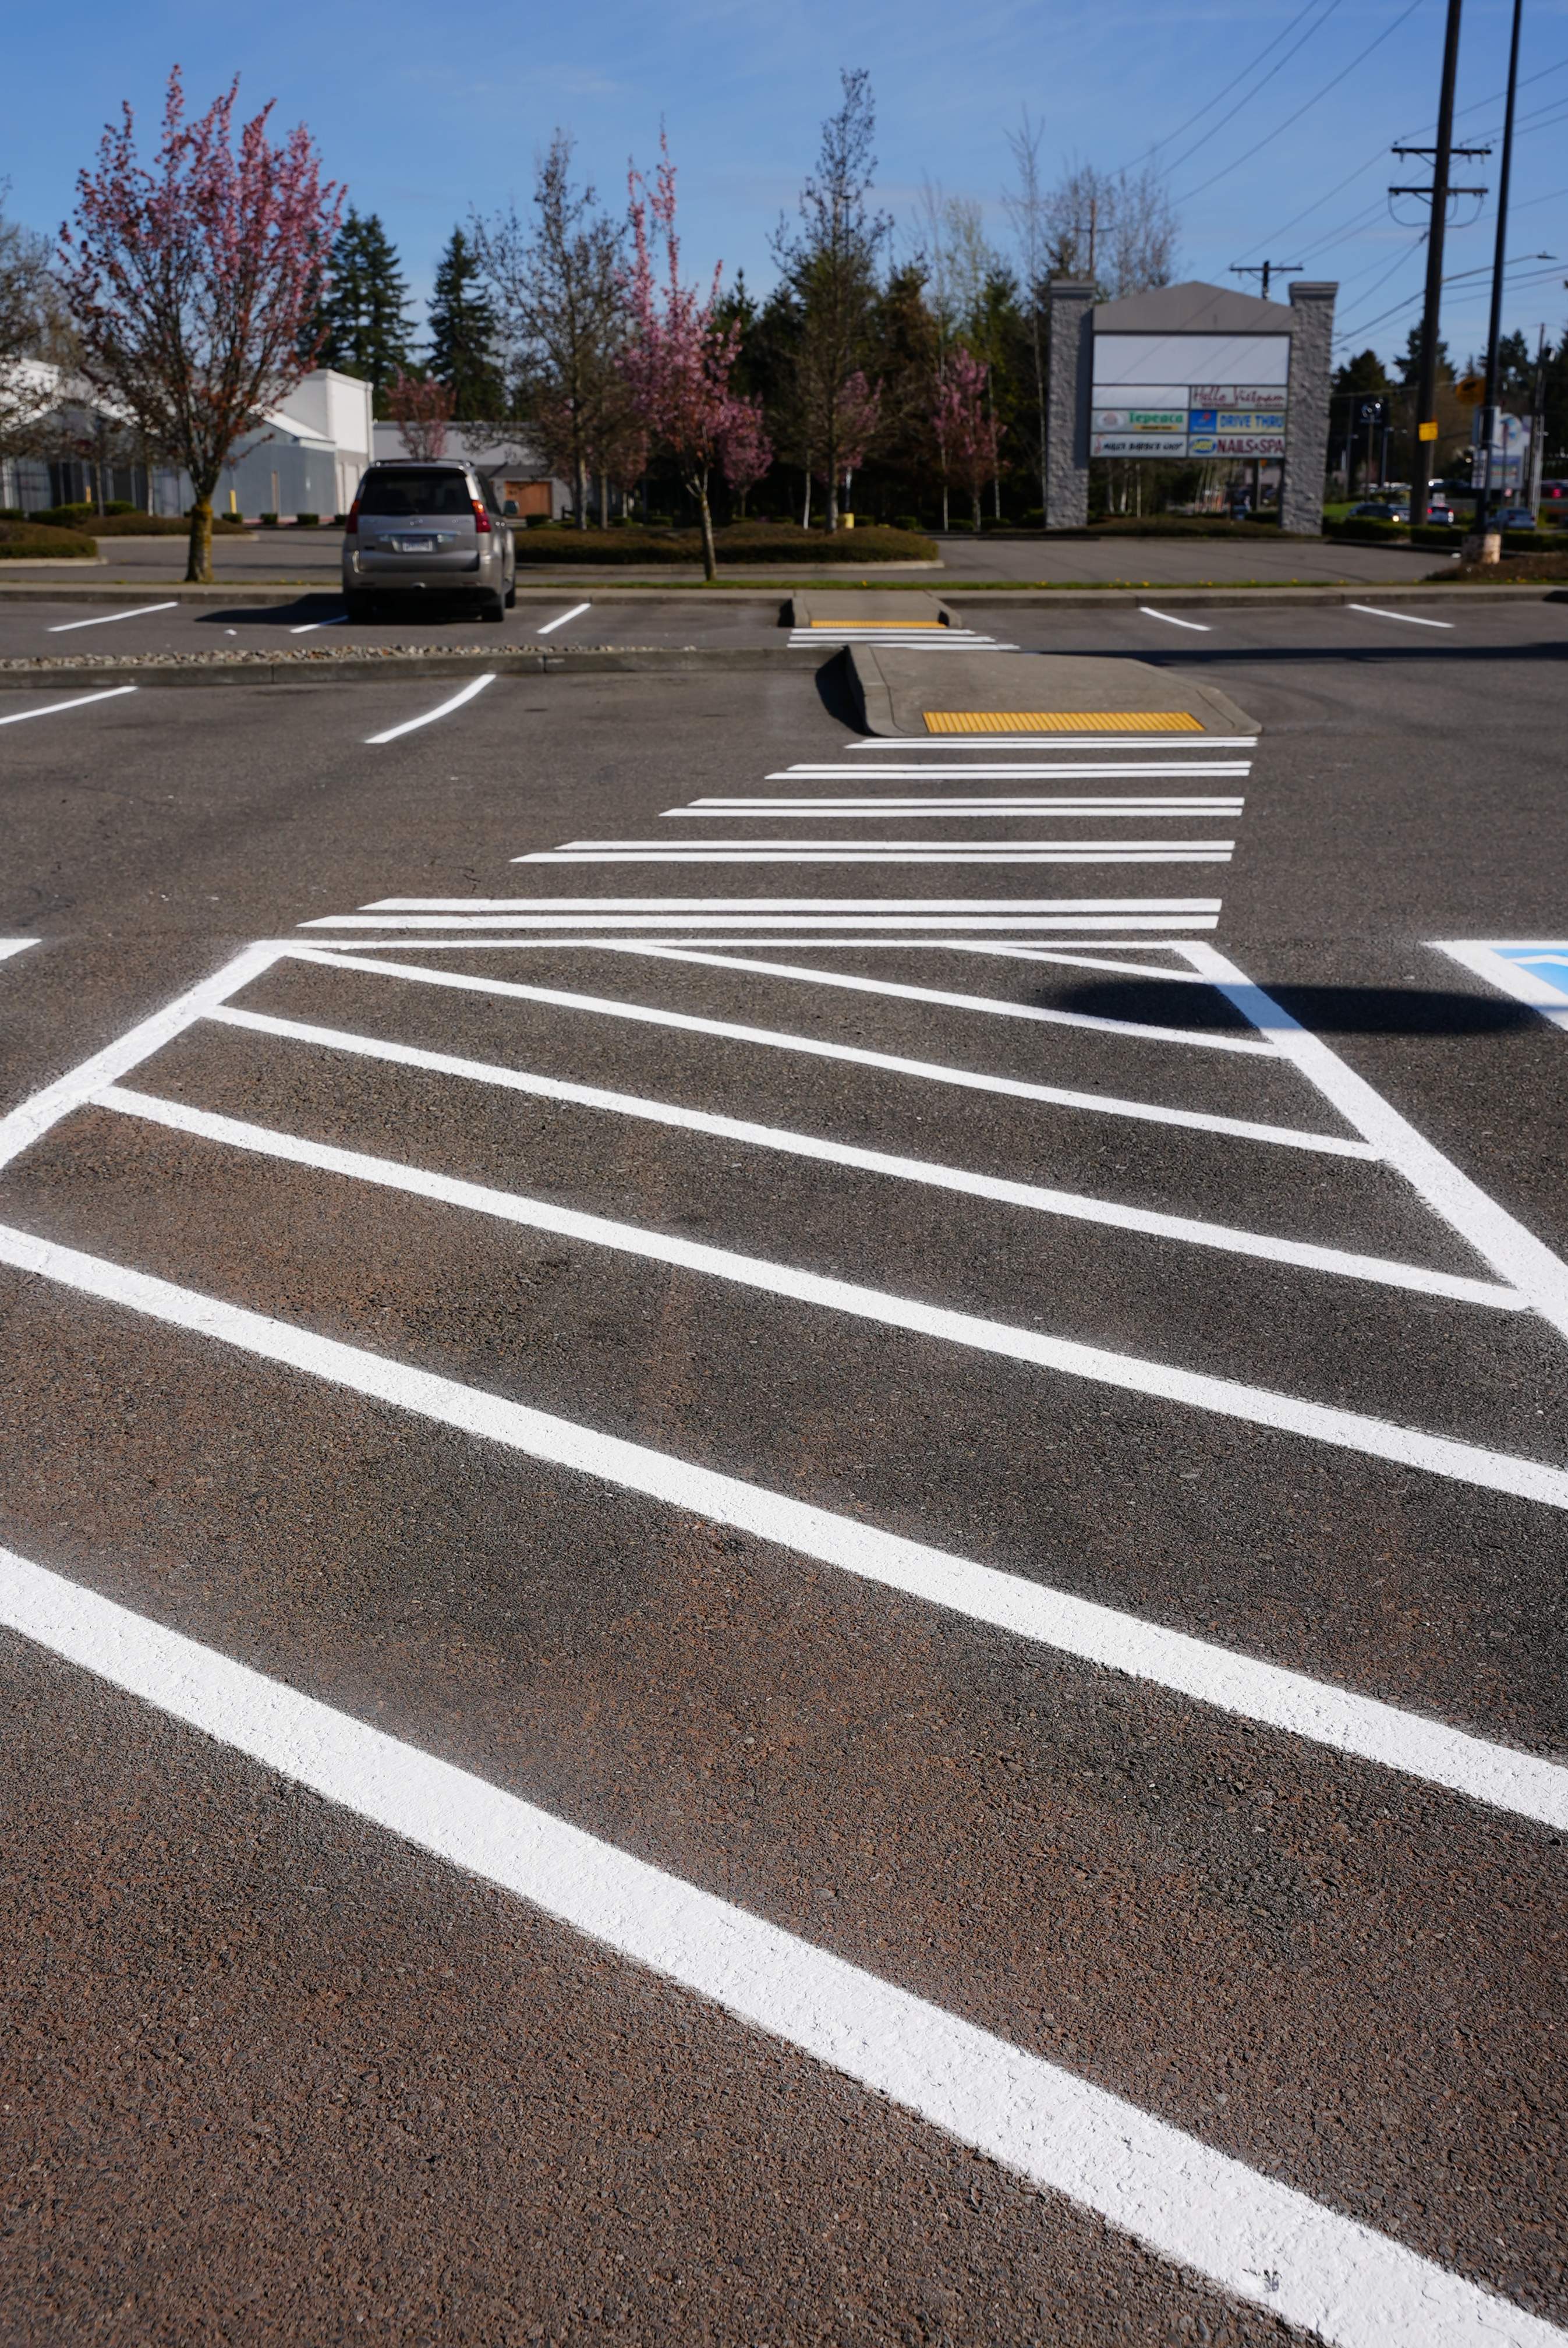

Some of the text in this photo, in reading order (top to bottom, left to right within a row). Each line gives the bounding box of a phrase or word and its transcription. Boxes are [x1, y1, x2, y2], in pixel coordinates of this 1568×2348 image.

[1129, 410, 1184, 424] Tepeaca
[1220, 415, 1286, 428] DRIVE THRU
[1217, 439, 1254, 453] NAILS
[1258, 439, 1286, 453] SPA
